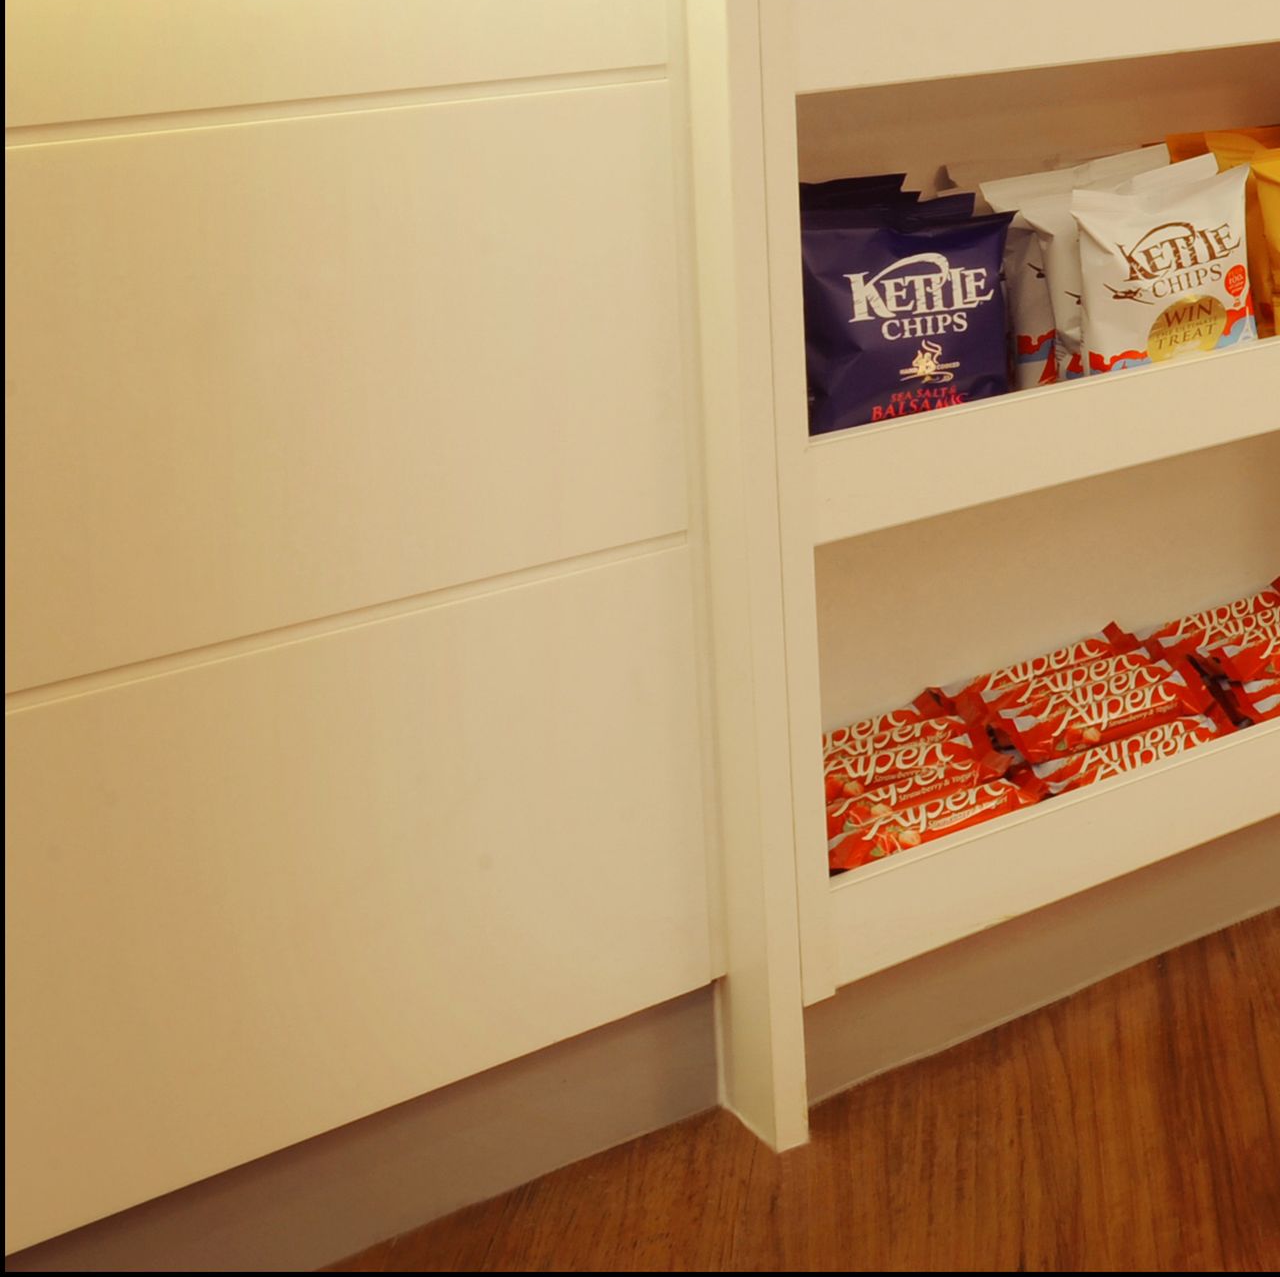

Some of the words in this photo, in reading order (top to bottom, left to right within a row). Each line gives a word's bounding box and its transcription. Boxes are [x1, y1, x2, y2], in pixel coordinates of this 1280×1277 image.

[1115, 222, 1241, 282] KETTLE
[843, 252, 995, 324] KETTLE
[1151, 263, 1223, 299] CHIPS
[880, 312, 969, 341] CHIPS
[1157, 325, 1216, 350] TREAT
[1164, 298, 1214, 328] WIN
[891, 391, 913, 402] SEA
[917, 386, 948, 398] SALT
[1176, 592, 1274, 637] Alpen
[985, 640, 1100, 693] Alpen
[1015, 653, 1141, 704] Alpen
[1035, 666, 1161, 721] Alpen
[1051, 682, 1177, 737] Alpen
[824, 741, 955, 786] Alpen
[1079, 719, 1186, 773] Alpen
[1094, 730, 1210, 785] Alpen
